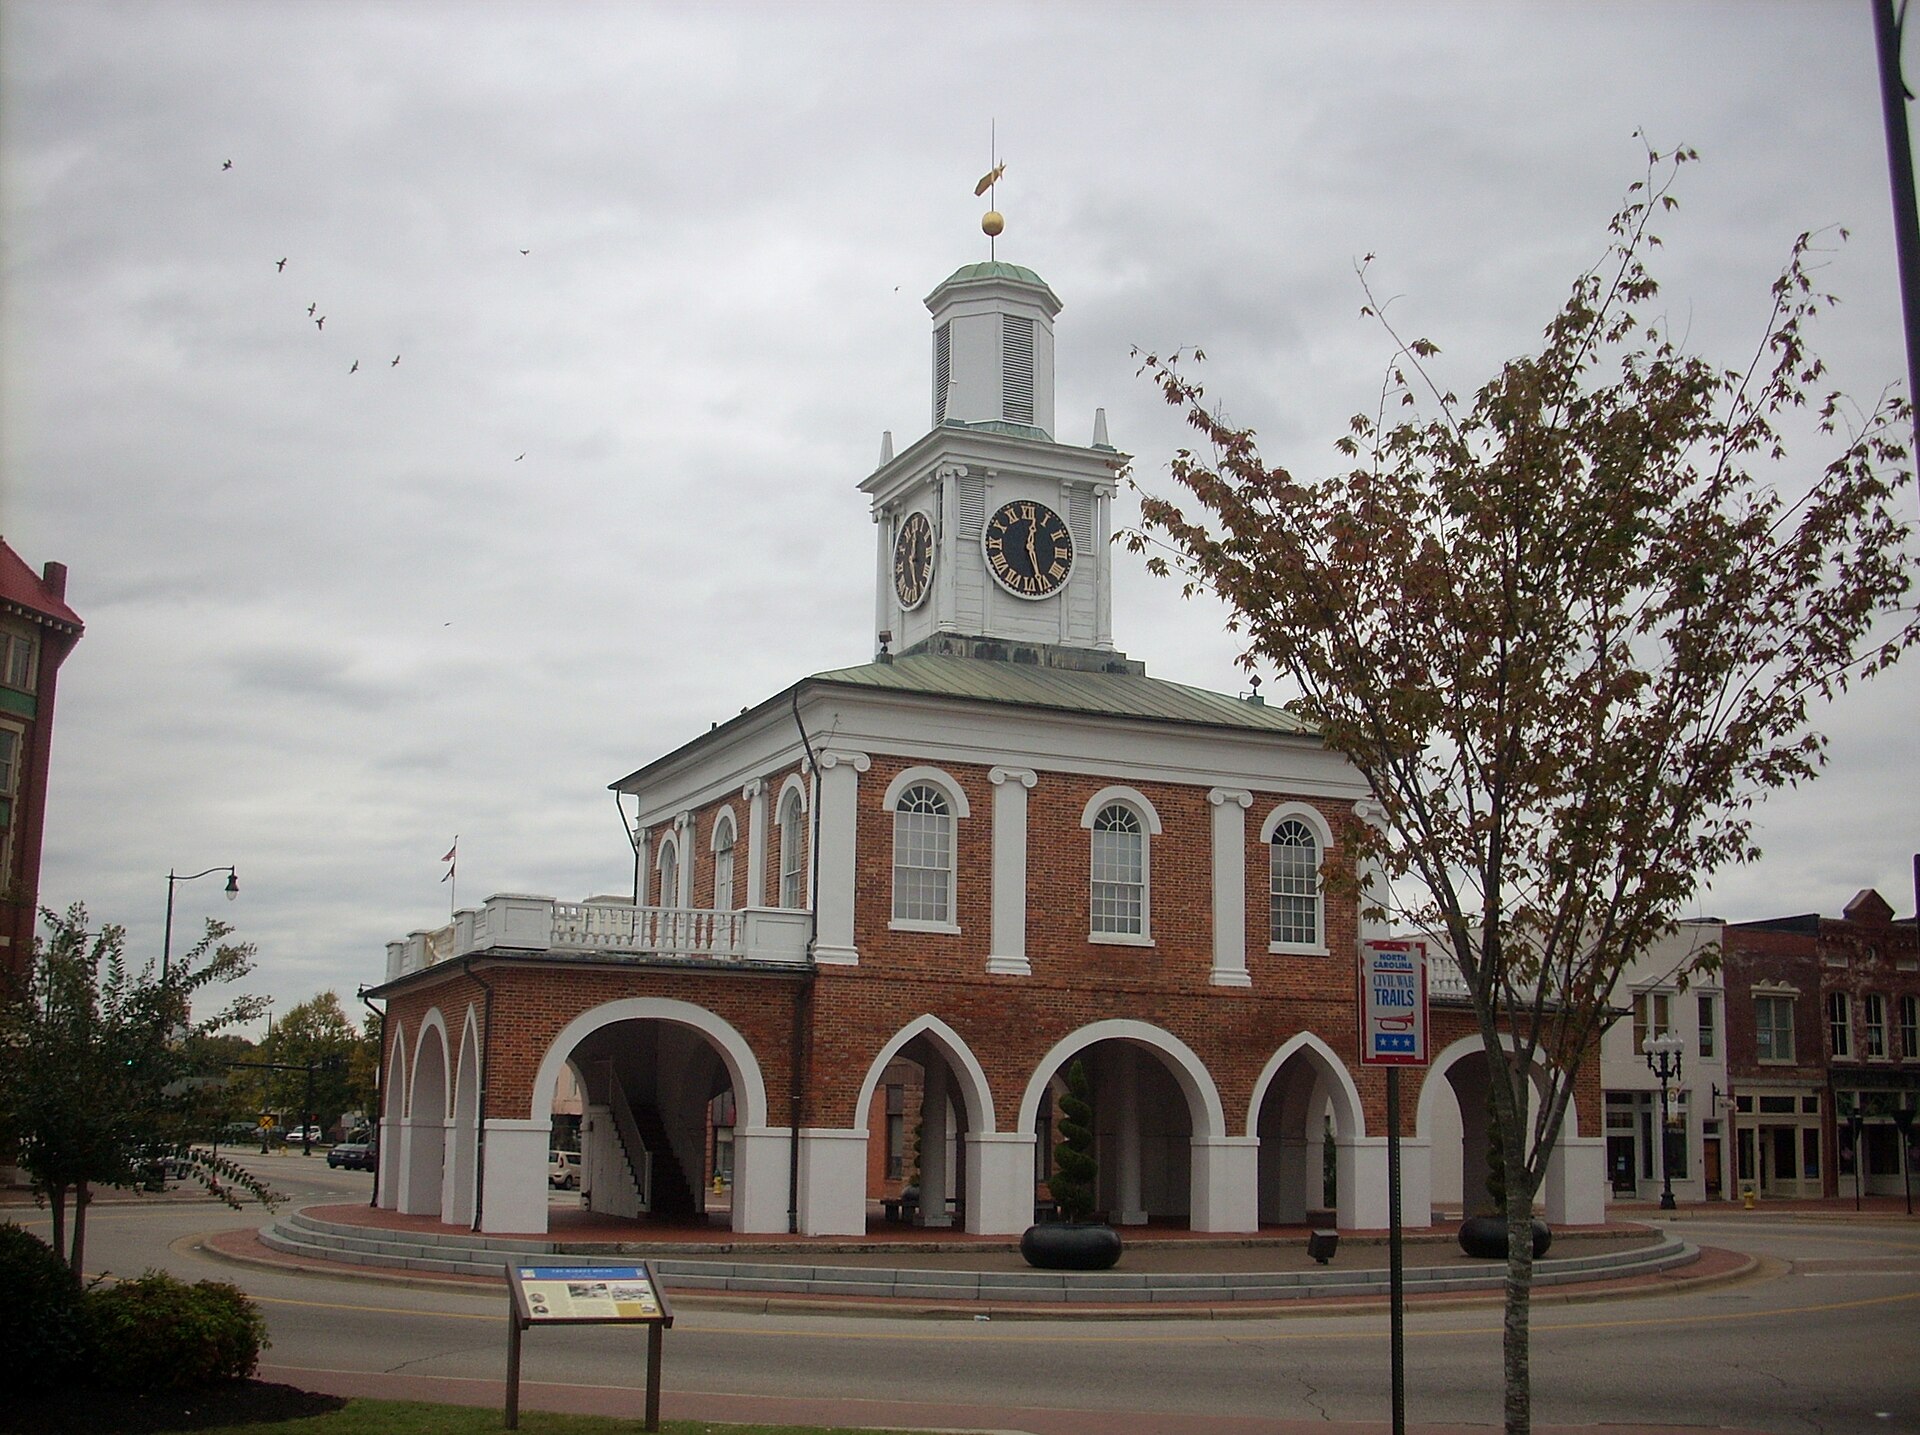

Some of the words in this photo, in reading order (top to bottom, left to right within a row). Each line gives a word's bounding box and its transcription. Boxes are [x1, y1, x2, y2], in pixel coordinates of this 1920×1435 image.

[1004, 508, 1019, 524] XI
[1021, 505, 1035, 519] XII
[993, 520, 1007, 533] X
[1040, 514, 1051, 527] I
[1050, 529, 1064, 542] II
[989, 536, 1002, 550] IX
[1054, 547, 1067, 559] III
[991, 552, 1008, 575] VIII
[1049, 561, 1065, 580] IIII
[1005, 568, 1021, 588] VII
[1023, 577, 1036, 591] VI
[1042, 575, 1052, 589] V
[1374, 975, 1394, 987] CIVIL
[1395, 976, 1414, 988] WAR
[1374, 989, 1414, 1007] TRAILS
